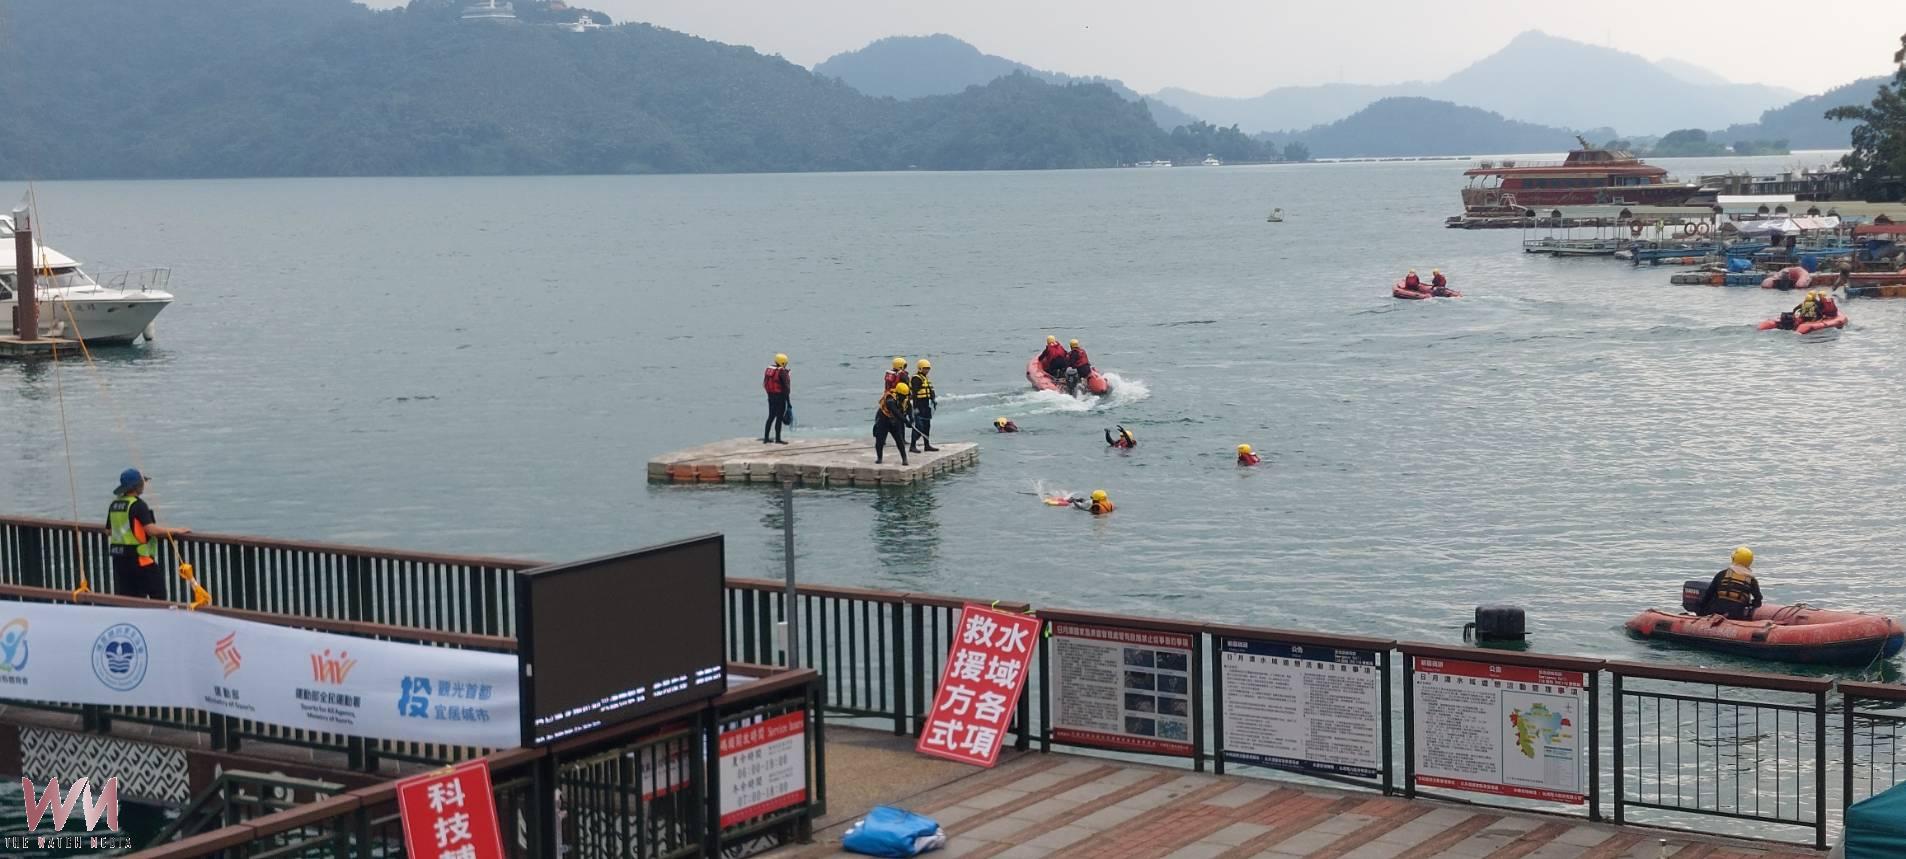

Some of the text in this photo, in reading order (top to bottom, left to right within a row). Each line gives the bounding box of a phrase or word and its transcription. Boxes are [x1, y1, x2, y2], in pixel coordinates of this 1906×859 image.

[438, 680, 493, 701] 觀光首都
[927, 614, 997, 750] 救援方式
[960, 623, 1029, 757] 水域各項
[296, 688, 361, 708] 運動部全民運動署
[434, 704, 490, 722] 宜居城市
